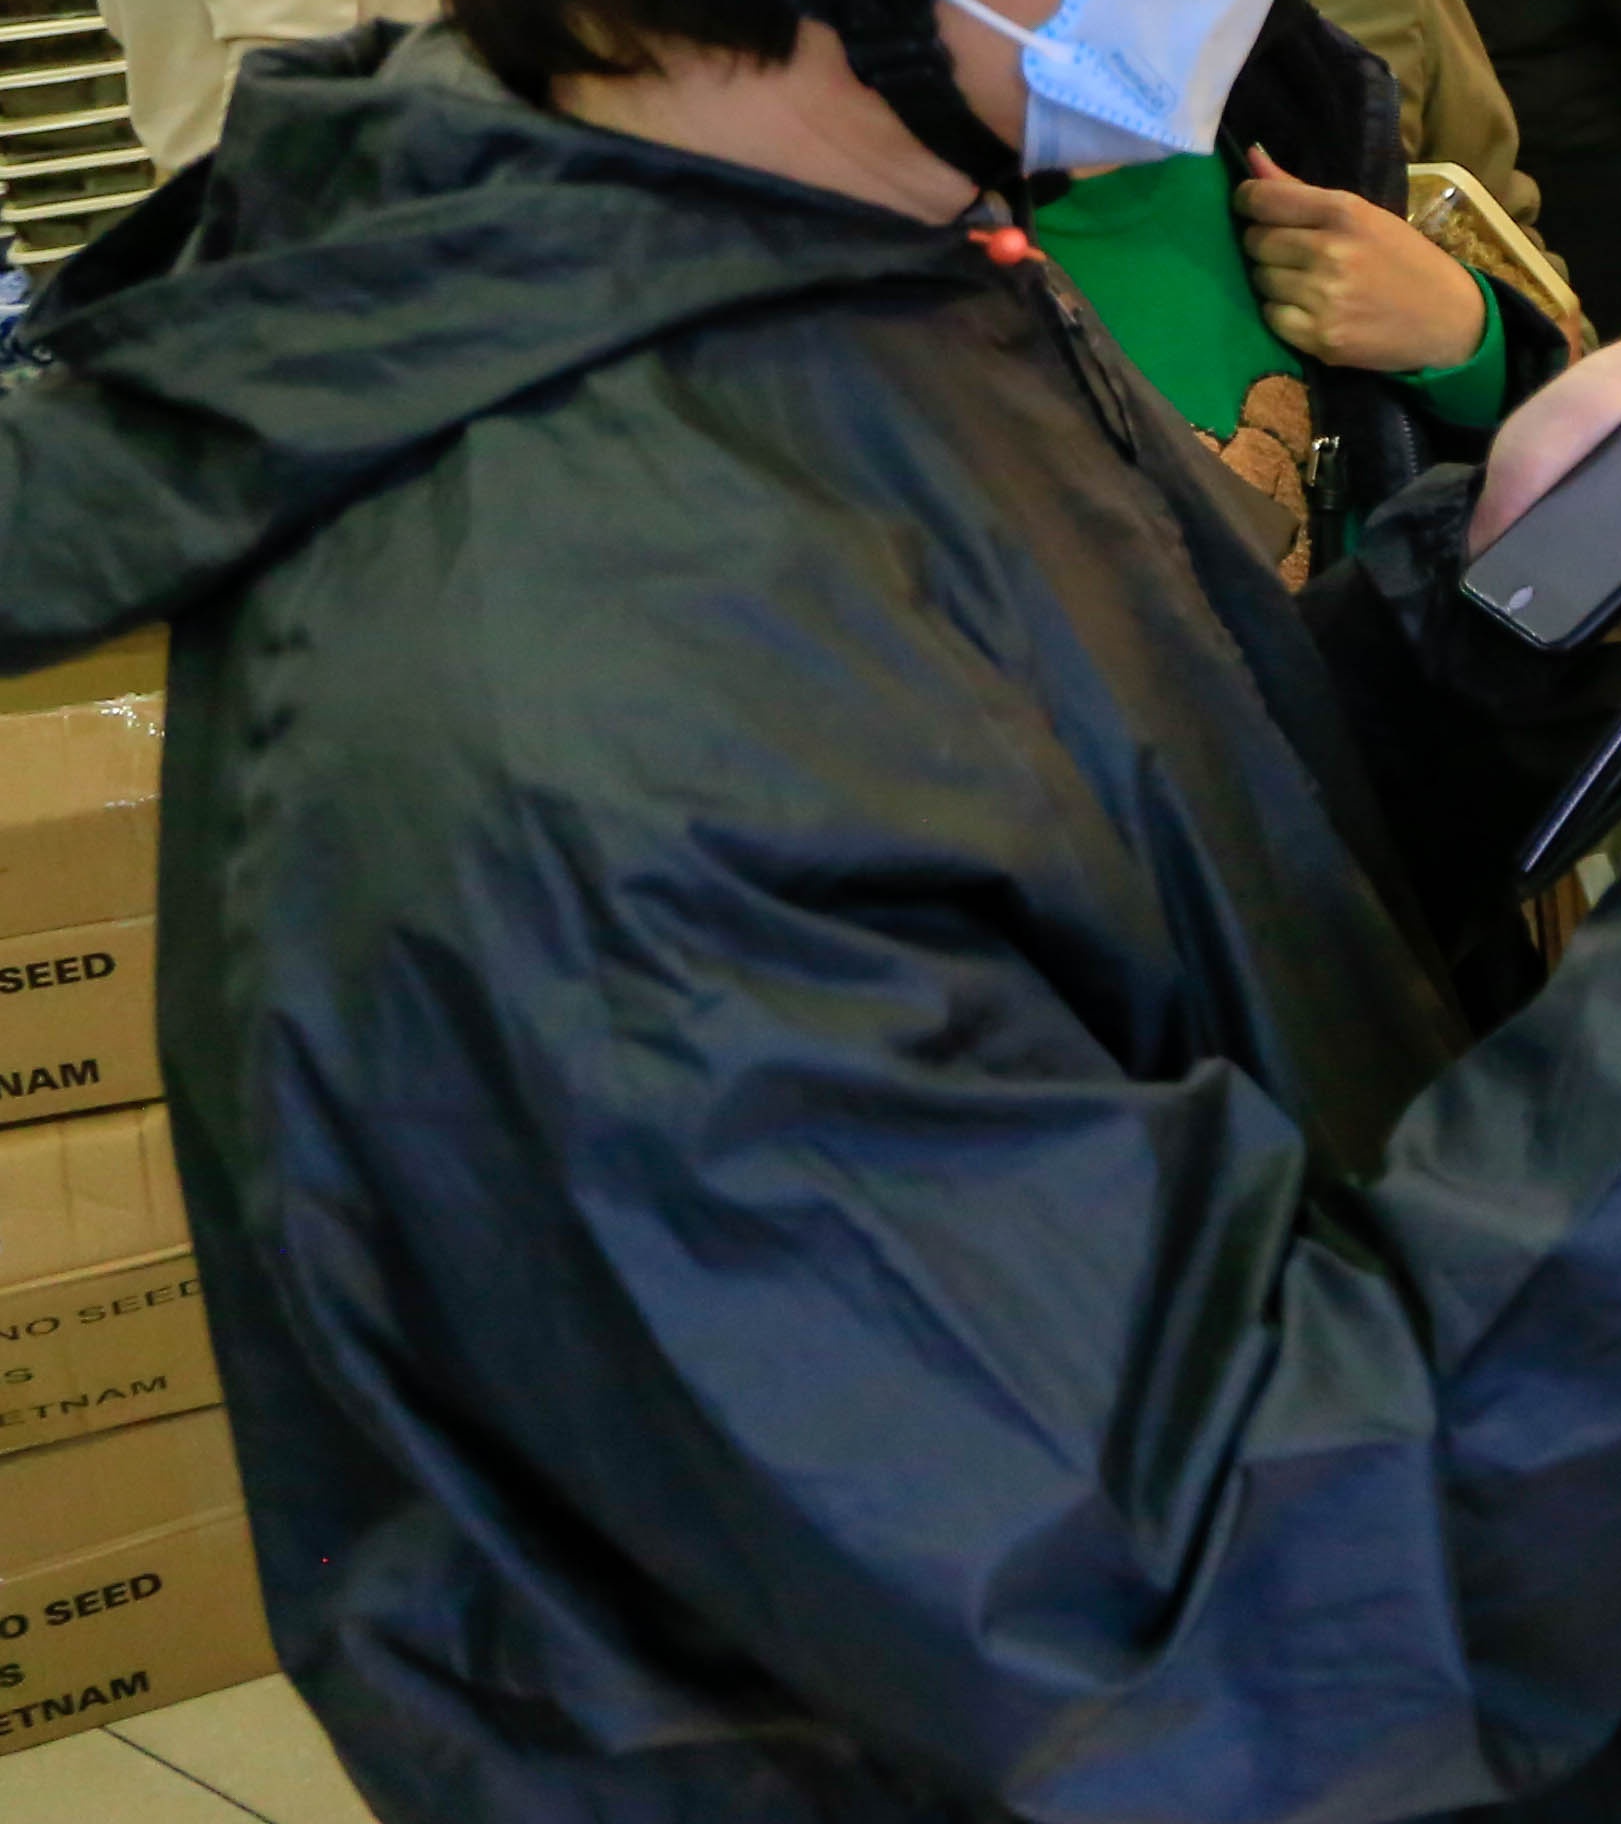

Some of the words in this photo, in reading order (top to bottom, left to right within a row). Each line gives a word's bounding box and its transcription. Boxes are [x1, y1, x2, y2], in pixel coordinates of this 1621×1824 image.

[0, 952, 116, 994] SEED
[77, 1278, 204, 1325] SEED
[44, 1572, 164, 1626] SEED
